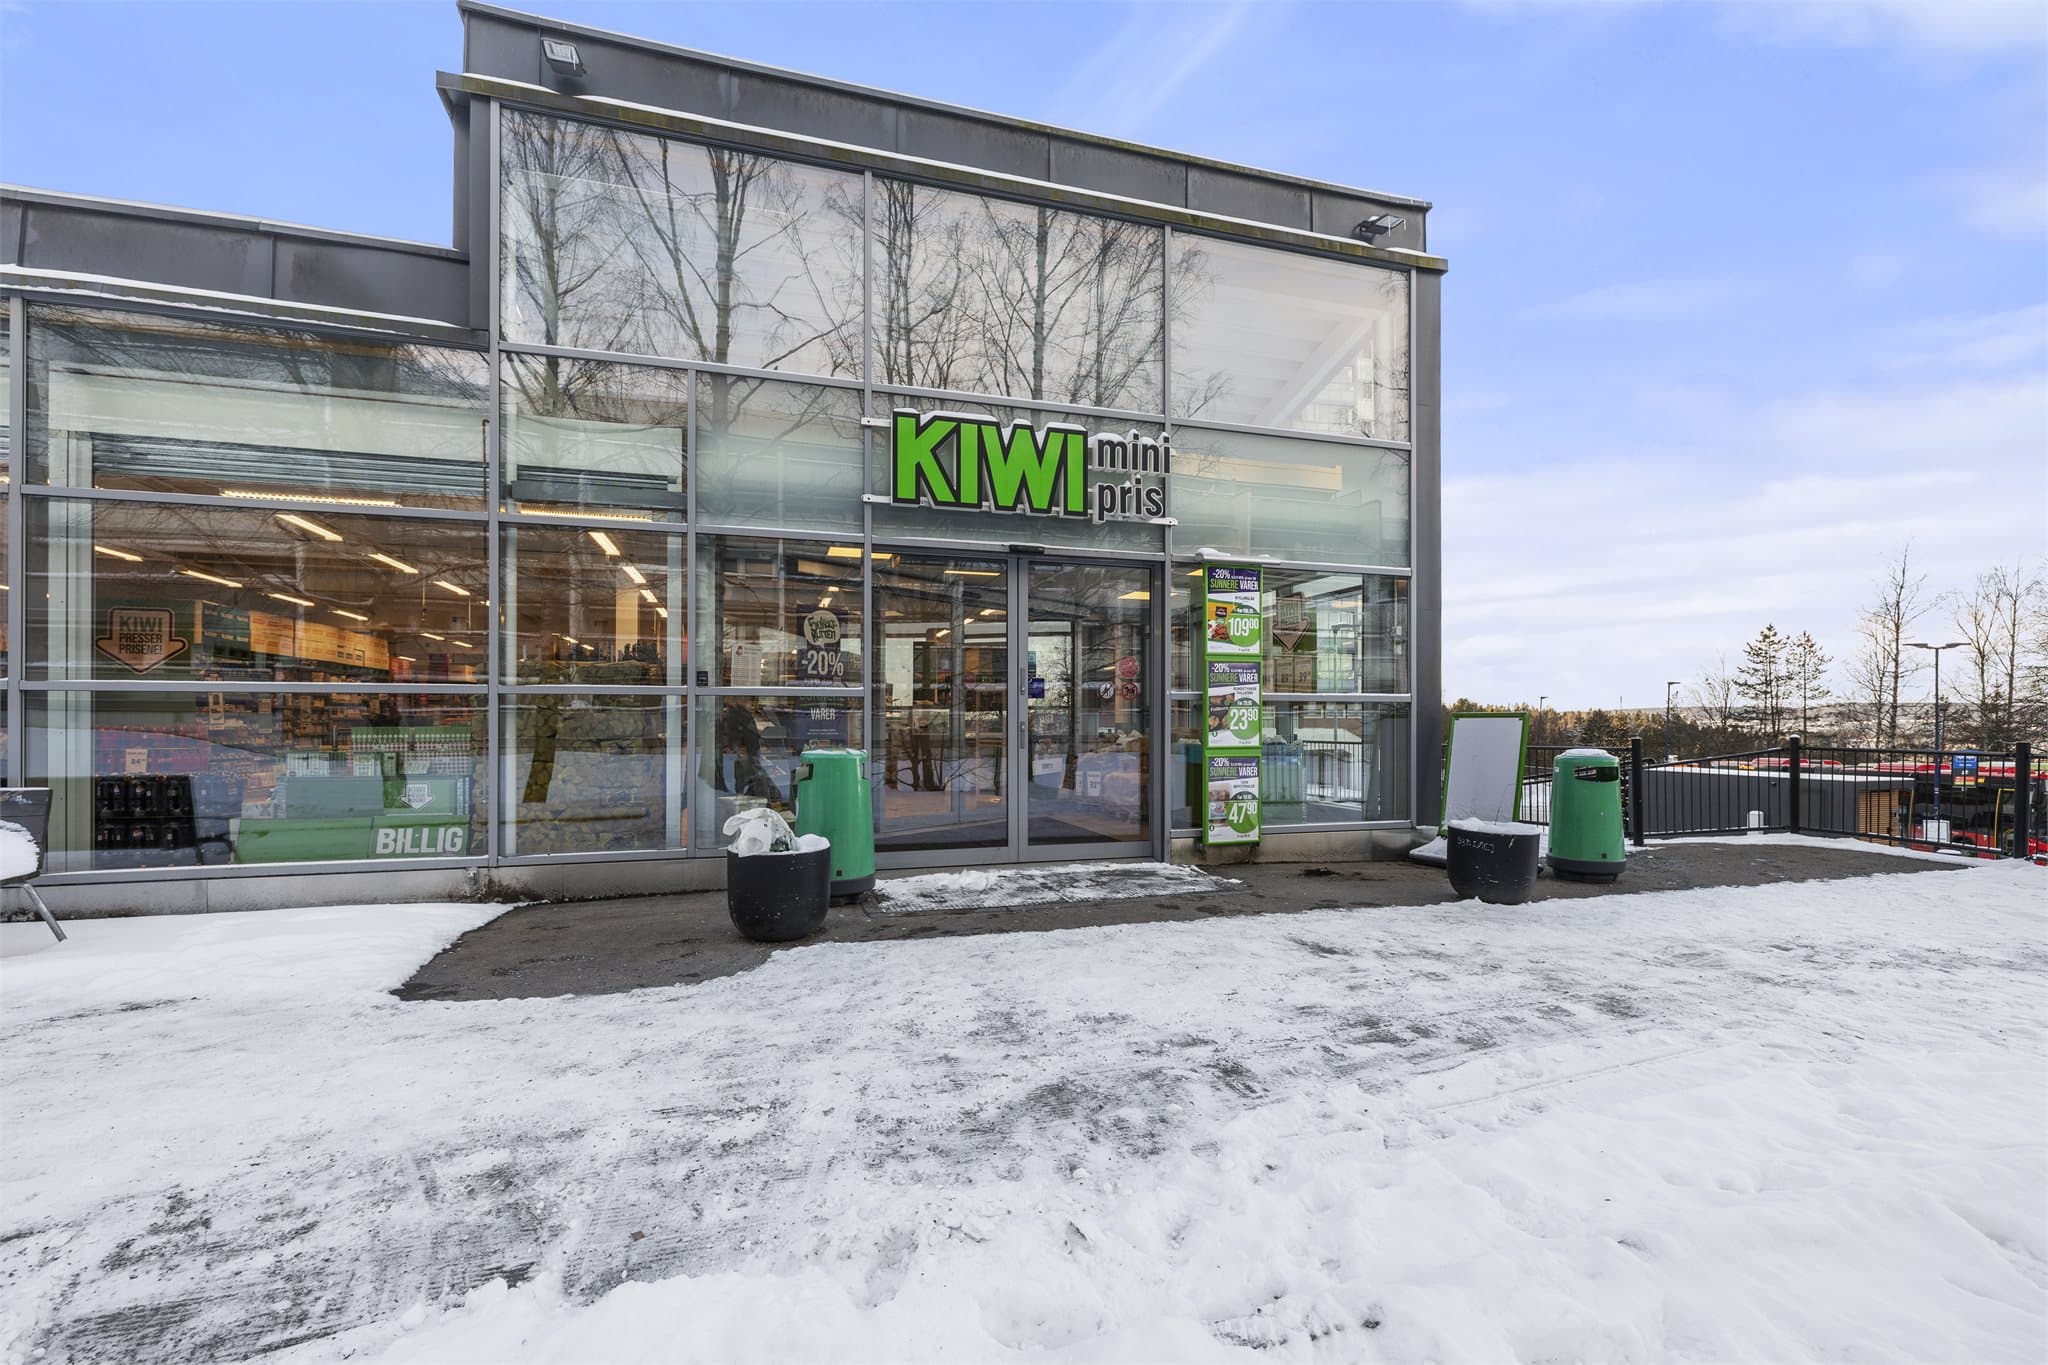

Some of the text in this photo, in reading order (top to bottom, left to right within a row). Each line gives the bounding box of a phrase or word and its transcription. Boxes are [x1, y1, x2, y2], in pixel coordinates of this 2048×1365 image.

[1097, 432, 1171, 474] mini
[892, 411, 1089, 517] KIWI
[1097, 475, 1164, 522] pris
[1213, 569, 1230, 578] -20%
[1210, 579, 1258, 590] SUNNERE VARER
[119, 616, 163, 632] KIWI
[119, 632, 163, 644] PRESSER
[119, 643, 163, 655] PRISENE!
[801, 650, 844, 676] -20%
[1211, 663, 1230, 673] -20%
[1239, 672, 1259, 682] VARER
[811, 707, 835, 720] VARER
[1211, 757, 1230, 767] -20%
[1238, 766, 1258, 777] VARER
[375, 826, 463, 854] BILLIG
